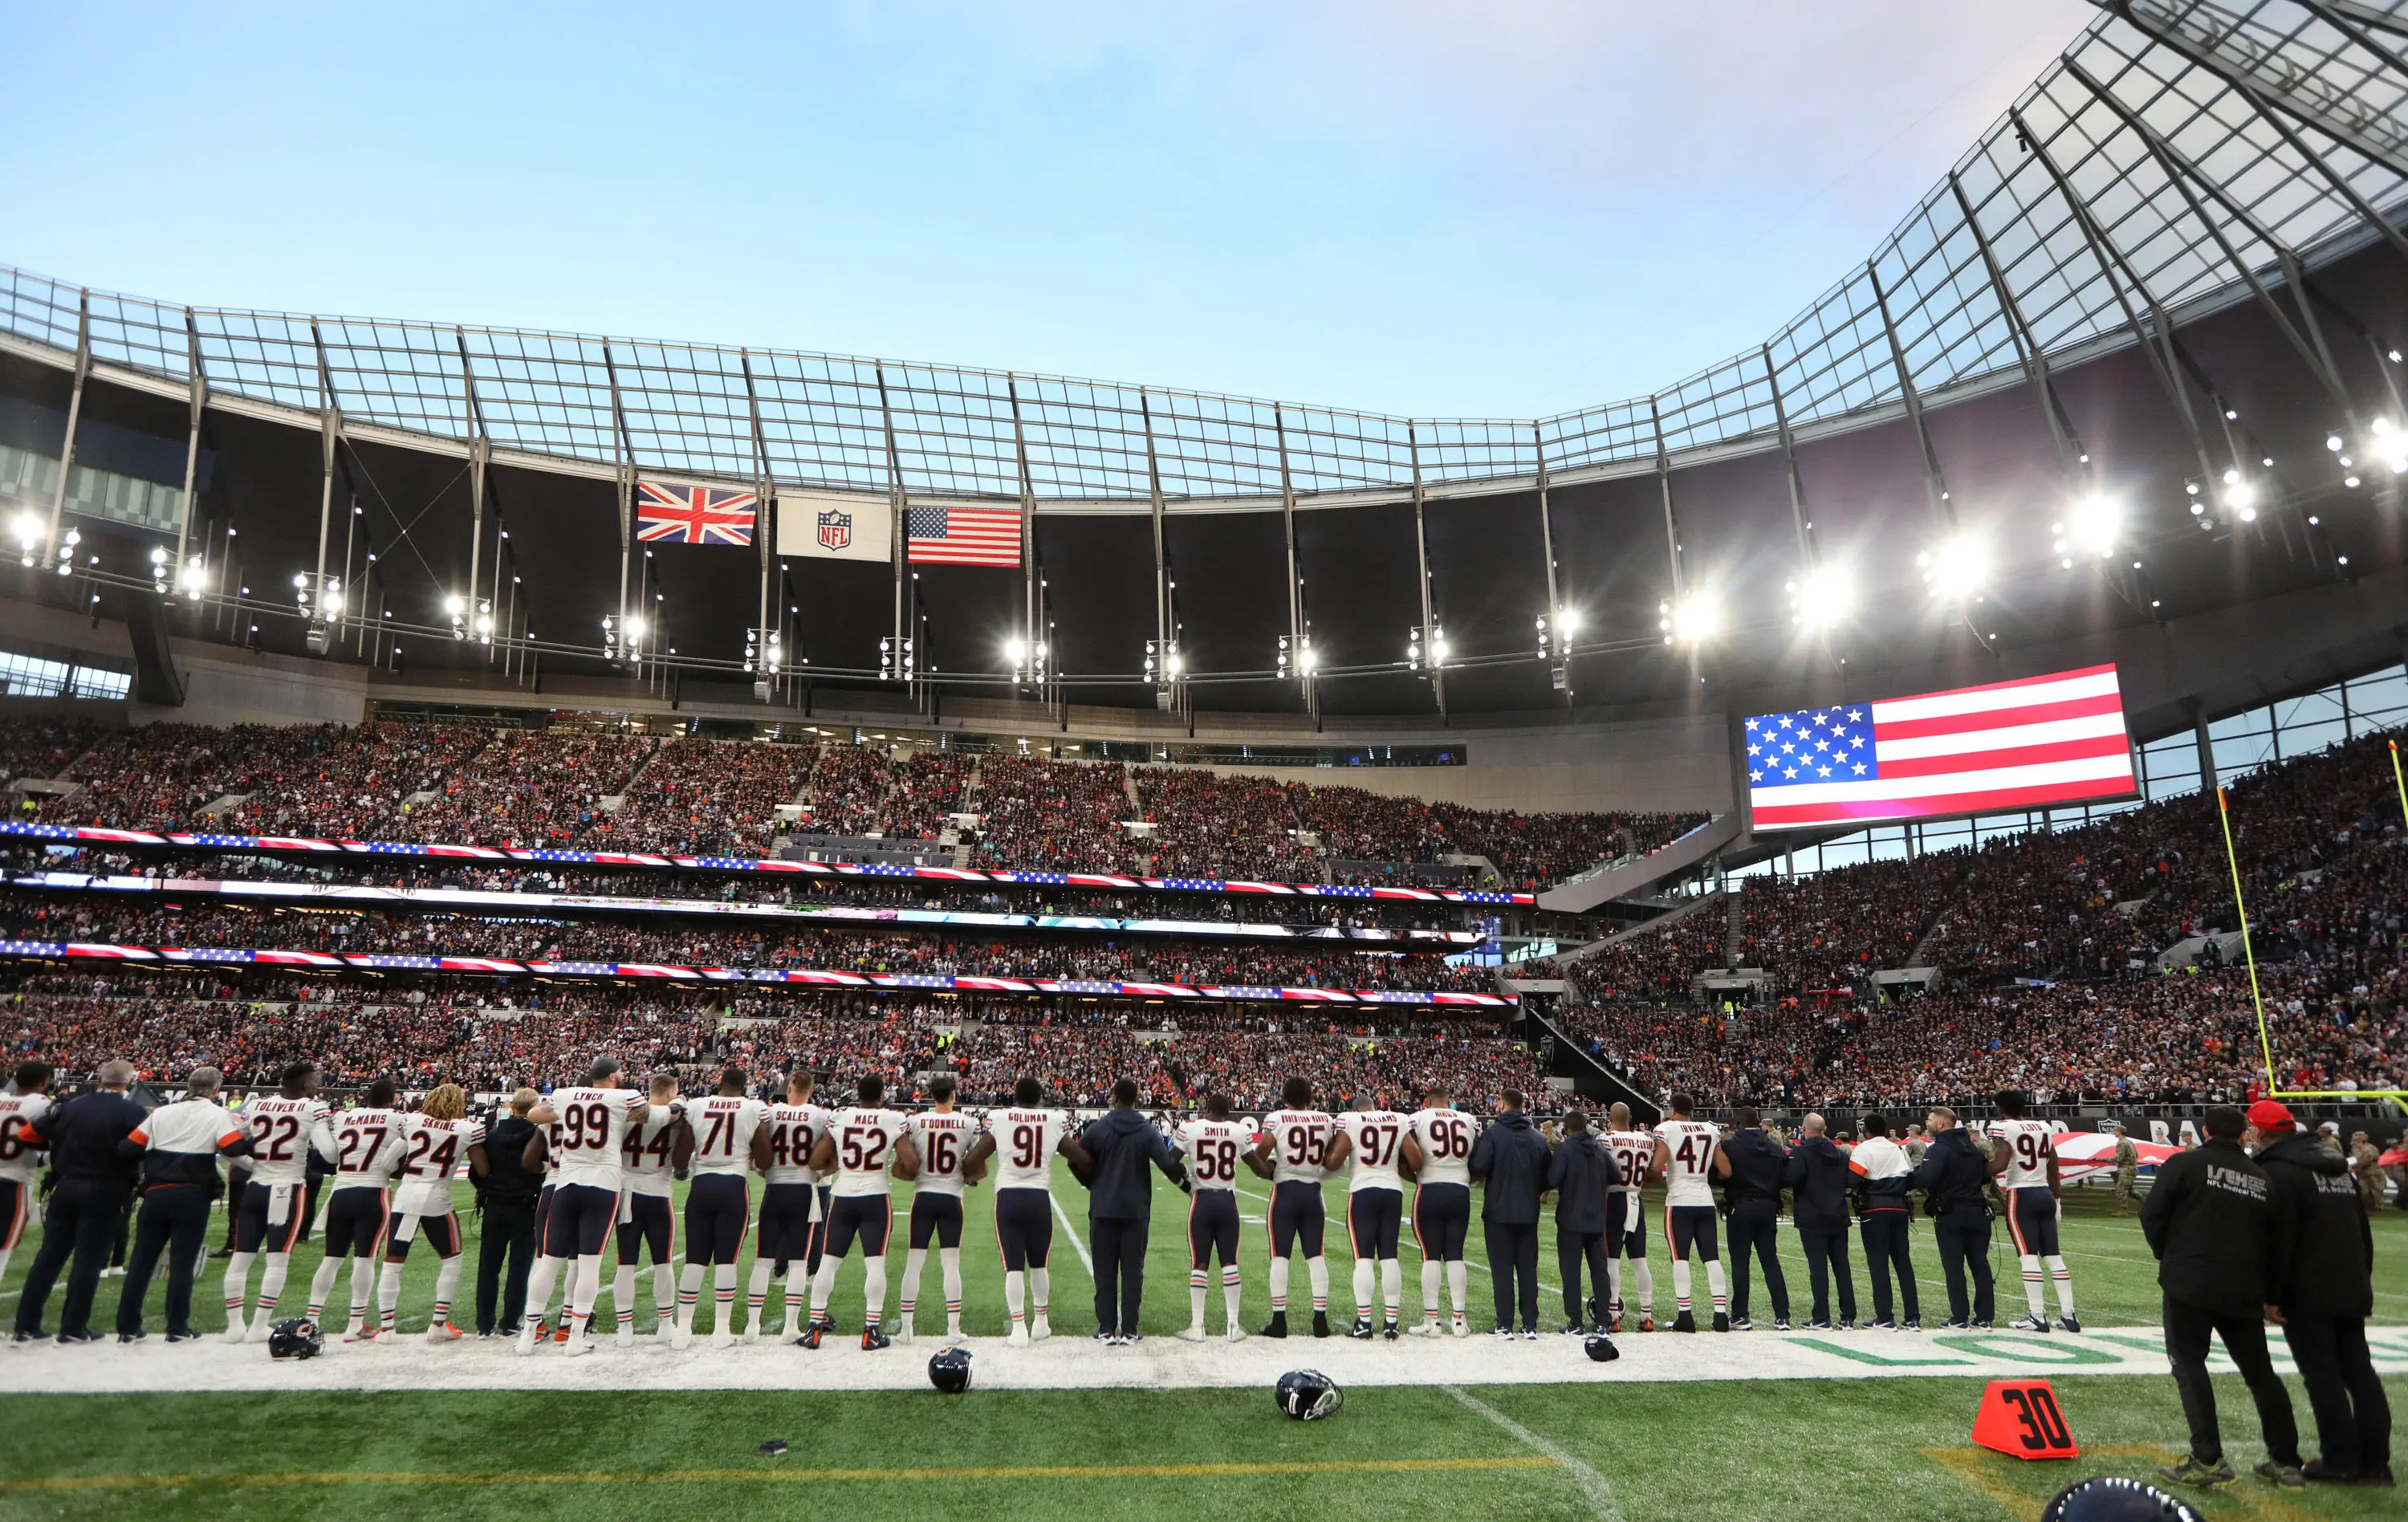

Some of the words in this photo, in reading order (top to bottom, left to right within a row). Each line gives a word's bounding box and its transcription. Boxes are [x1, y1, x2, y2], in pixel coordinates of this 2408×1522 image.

[820, 526, 848, 547] NFL
[0, 1101, 22, 1111] USH
[254, 1101, 294, 1113] TOLIVER
[574, 1092, 605, 1101] LYNCH
[708, 1101, 742, 1109] HARRIS
[775, 1111, 809, 1121] SCALES
[344, 1114, 387, 1126] McMANIS
[421, 1117, 458, 1132] SKRINE
[563, 1103, 610, 1150] 99
[700, 1111, 736, 1156] 71
[855, 1114, 879, 1125] MACK
[921, 1118, 966, 1129] O'DONNELL
[1008, 1113, 1047, 1122] GOLDMAN
[1204, 1126, 1230, 1137] SMITH
[1361, 1114, 1397, 1124] WILLIAMS
[1680, 1124, 1705, 1133] IRVING
[2019, 1123, 2043, 1132] FLOYD
[0, 1114, 30, 1161] 6
[252, 1114, 299, 1162] 22
[338, 1127, 388, 1172] 27
[405, 1129, 459, 1178] 24
[621, 1122, 671, 1168] 44
[771, 1124, 813, 1167] 48
[843, 1126, 887, 1171] 52
[927, 1131, 958, 1174] 16
[1012, 1125, 1043, 1169] 91
[1287, 1125, 1325, 1166] 95
[1360, 1125, 1399, 1166] 97
[1430, 1119, 1469, 1159] 96
[1676, 1134, 1712, 1174] 47
[2016, 1132, 2050, 1171] 94
[1196, 1139, 1237, 1182] 58
[1617, 1150, 1649, 1187] 36
[2207, 1178, 2222, 1188] NFL
[2223, 1182, 2249, 1195] Medical
[2250, 1190, 2267, 1202] Team
[2001, 1388, 2072, 1450] 30
